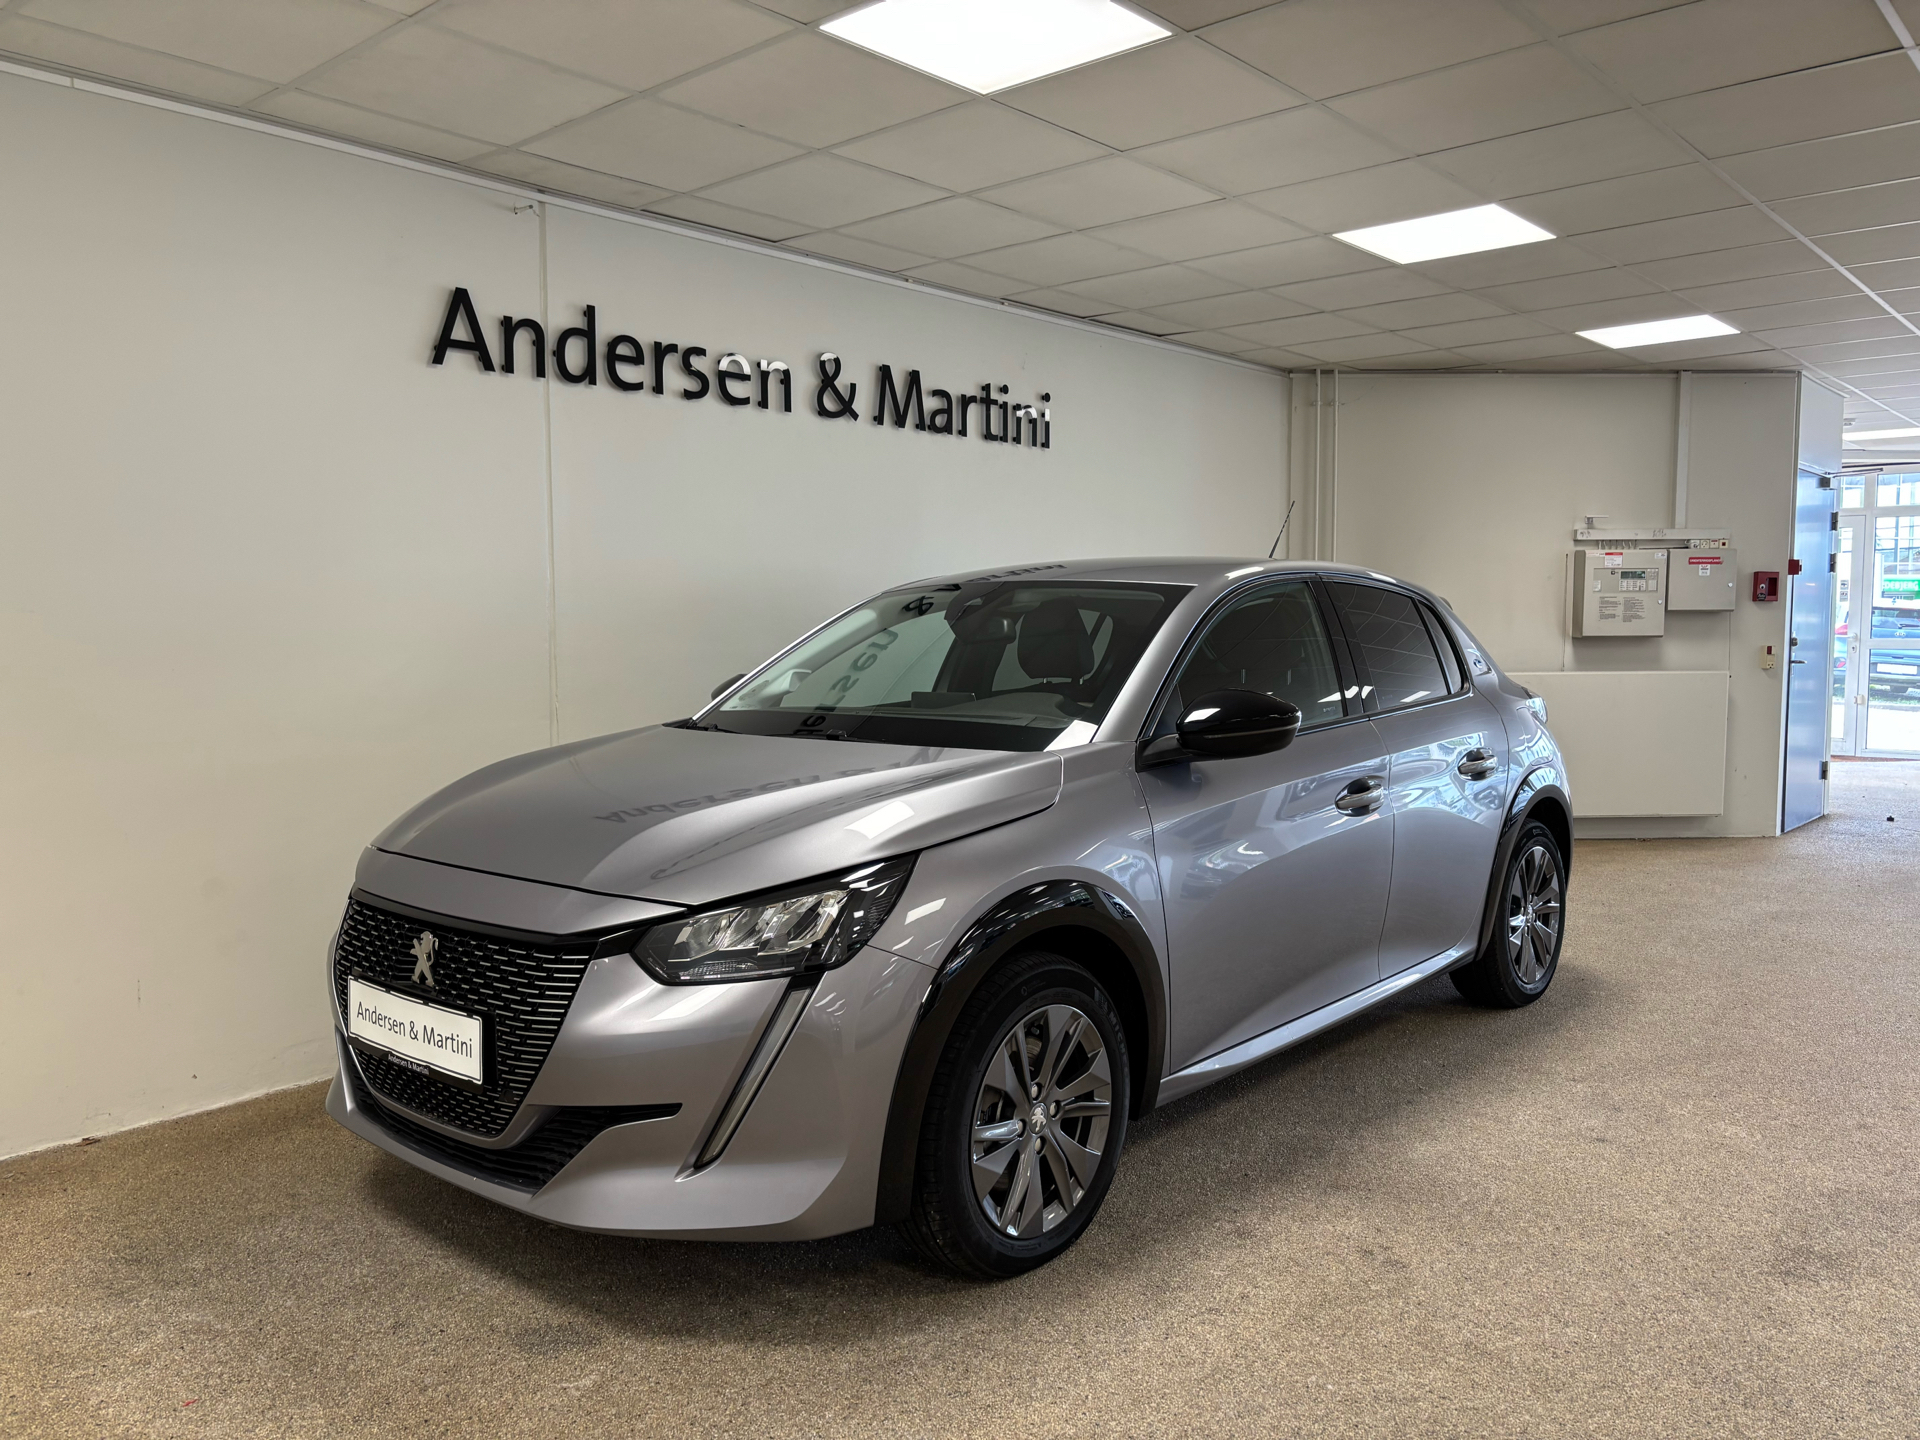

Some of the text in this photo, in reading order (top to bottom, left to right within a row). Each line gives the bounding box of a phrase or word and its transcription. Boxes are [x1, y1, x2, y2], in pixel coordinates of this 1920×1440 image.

[431, 286, 1052, 449] Andersen & Martini
[356, 1000, 473, 1059] Andersen & Martini
[388, 1053, 407, 1068] Andersen
[412, 1062, 430, 1076] Martini
